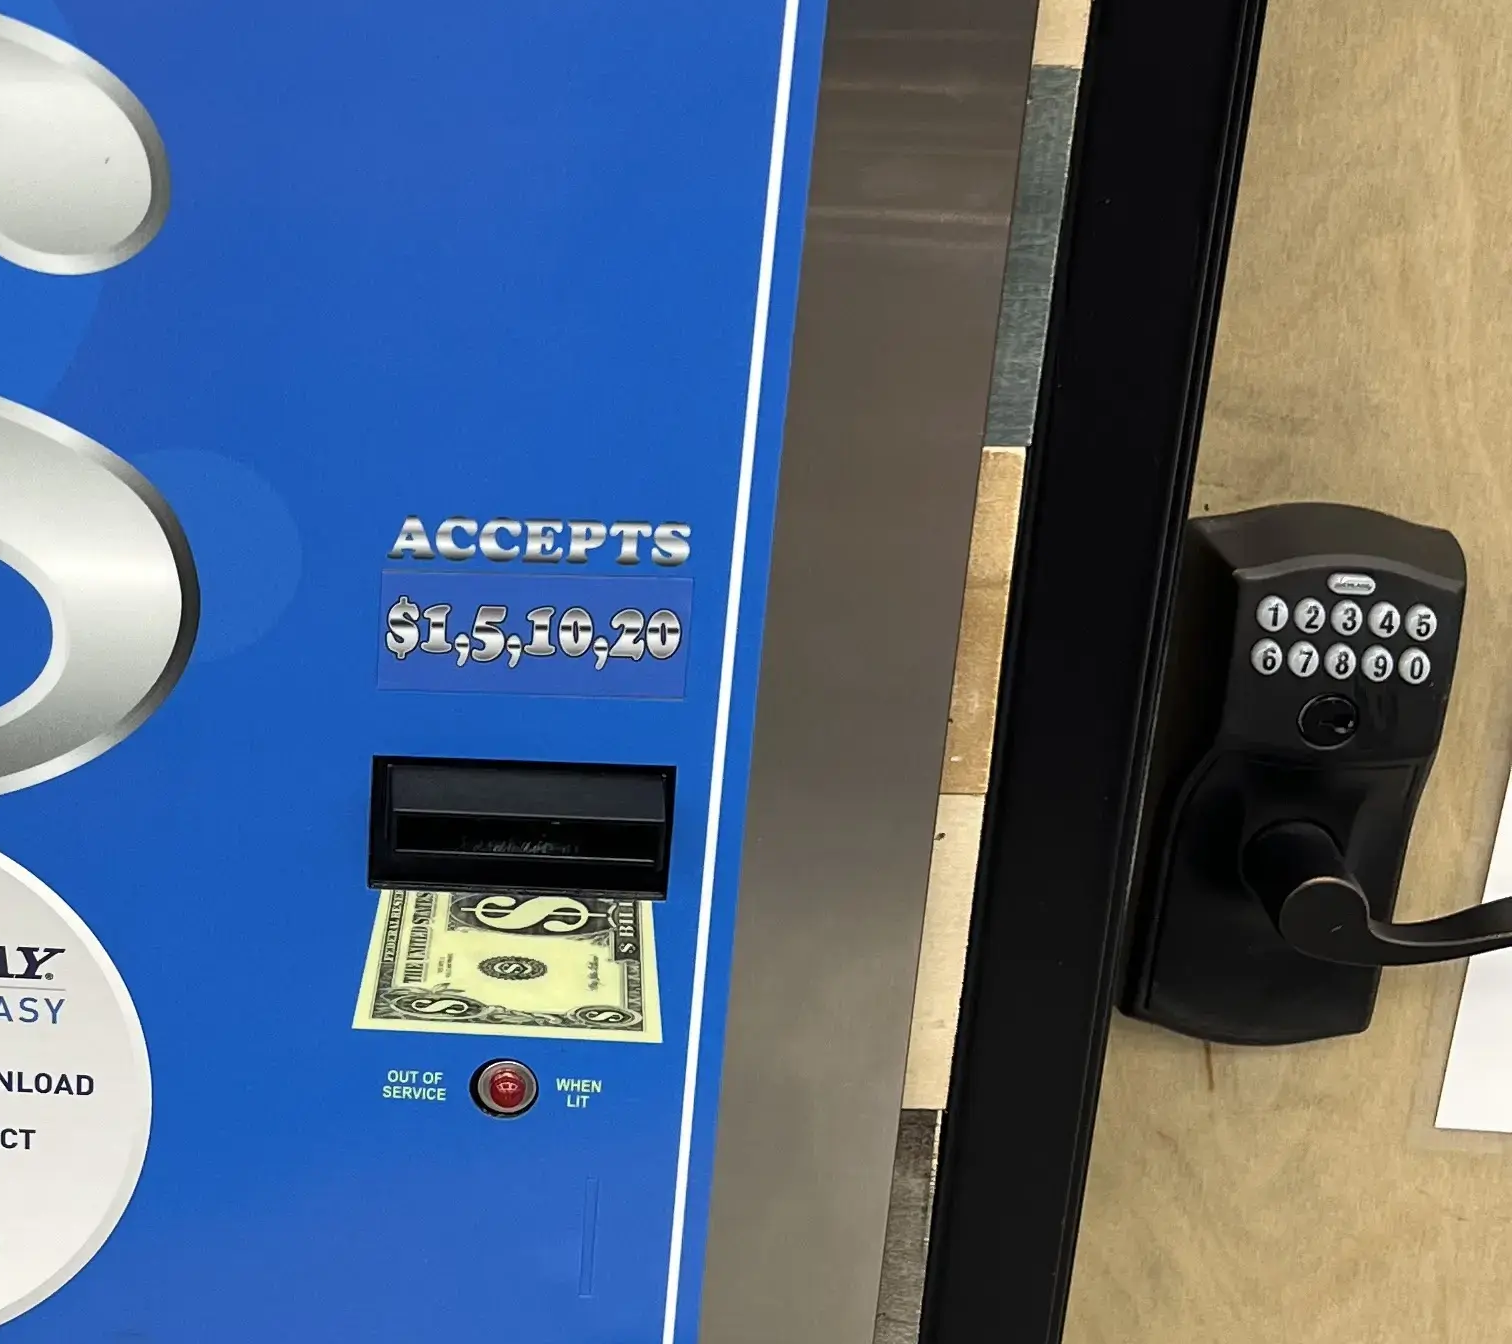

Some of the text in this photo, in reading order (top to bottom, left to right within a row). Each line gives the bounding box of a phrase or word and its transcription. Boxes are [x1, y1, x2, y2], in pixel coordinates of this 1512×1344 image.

[387, 515, 692, 567] ACCEPTS
[385, 595, 683, 671] $1,5,10,20
[1269, 603, 1431, 637] 1 2 3 4 5
[1262, 648, 1423, 680] 6 7 8 9 0
[403, 892, 434, 983] THE UNITED STATES
[382, 1085, 447, 1101] SERVICE
[387, 1069, 444, 1085] OUT OF
[556, 1078, 602, 1093] WHEN
[566, 1094, 590, 1108] LIT
